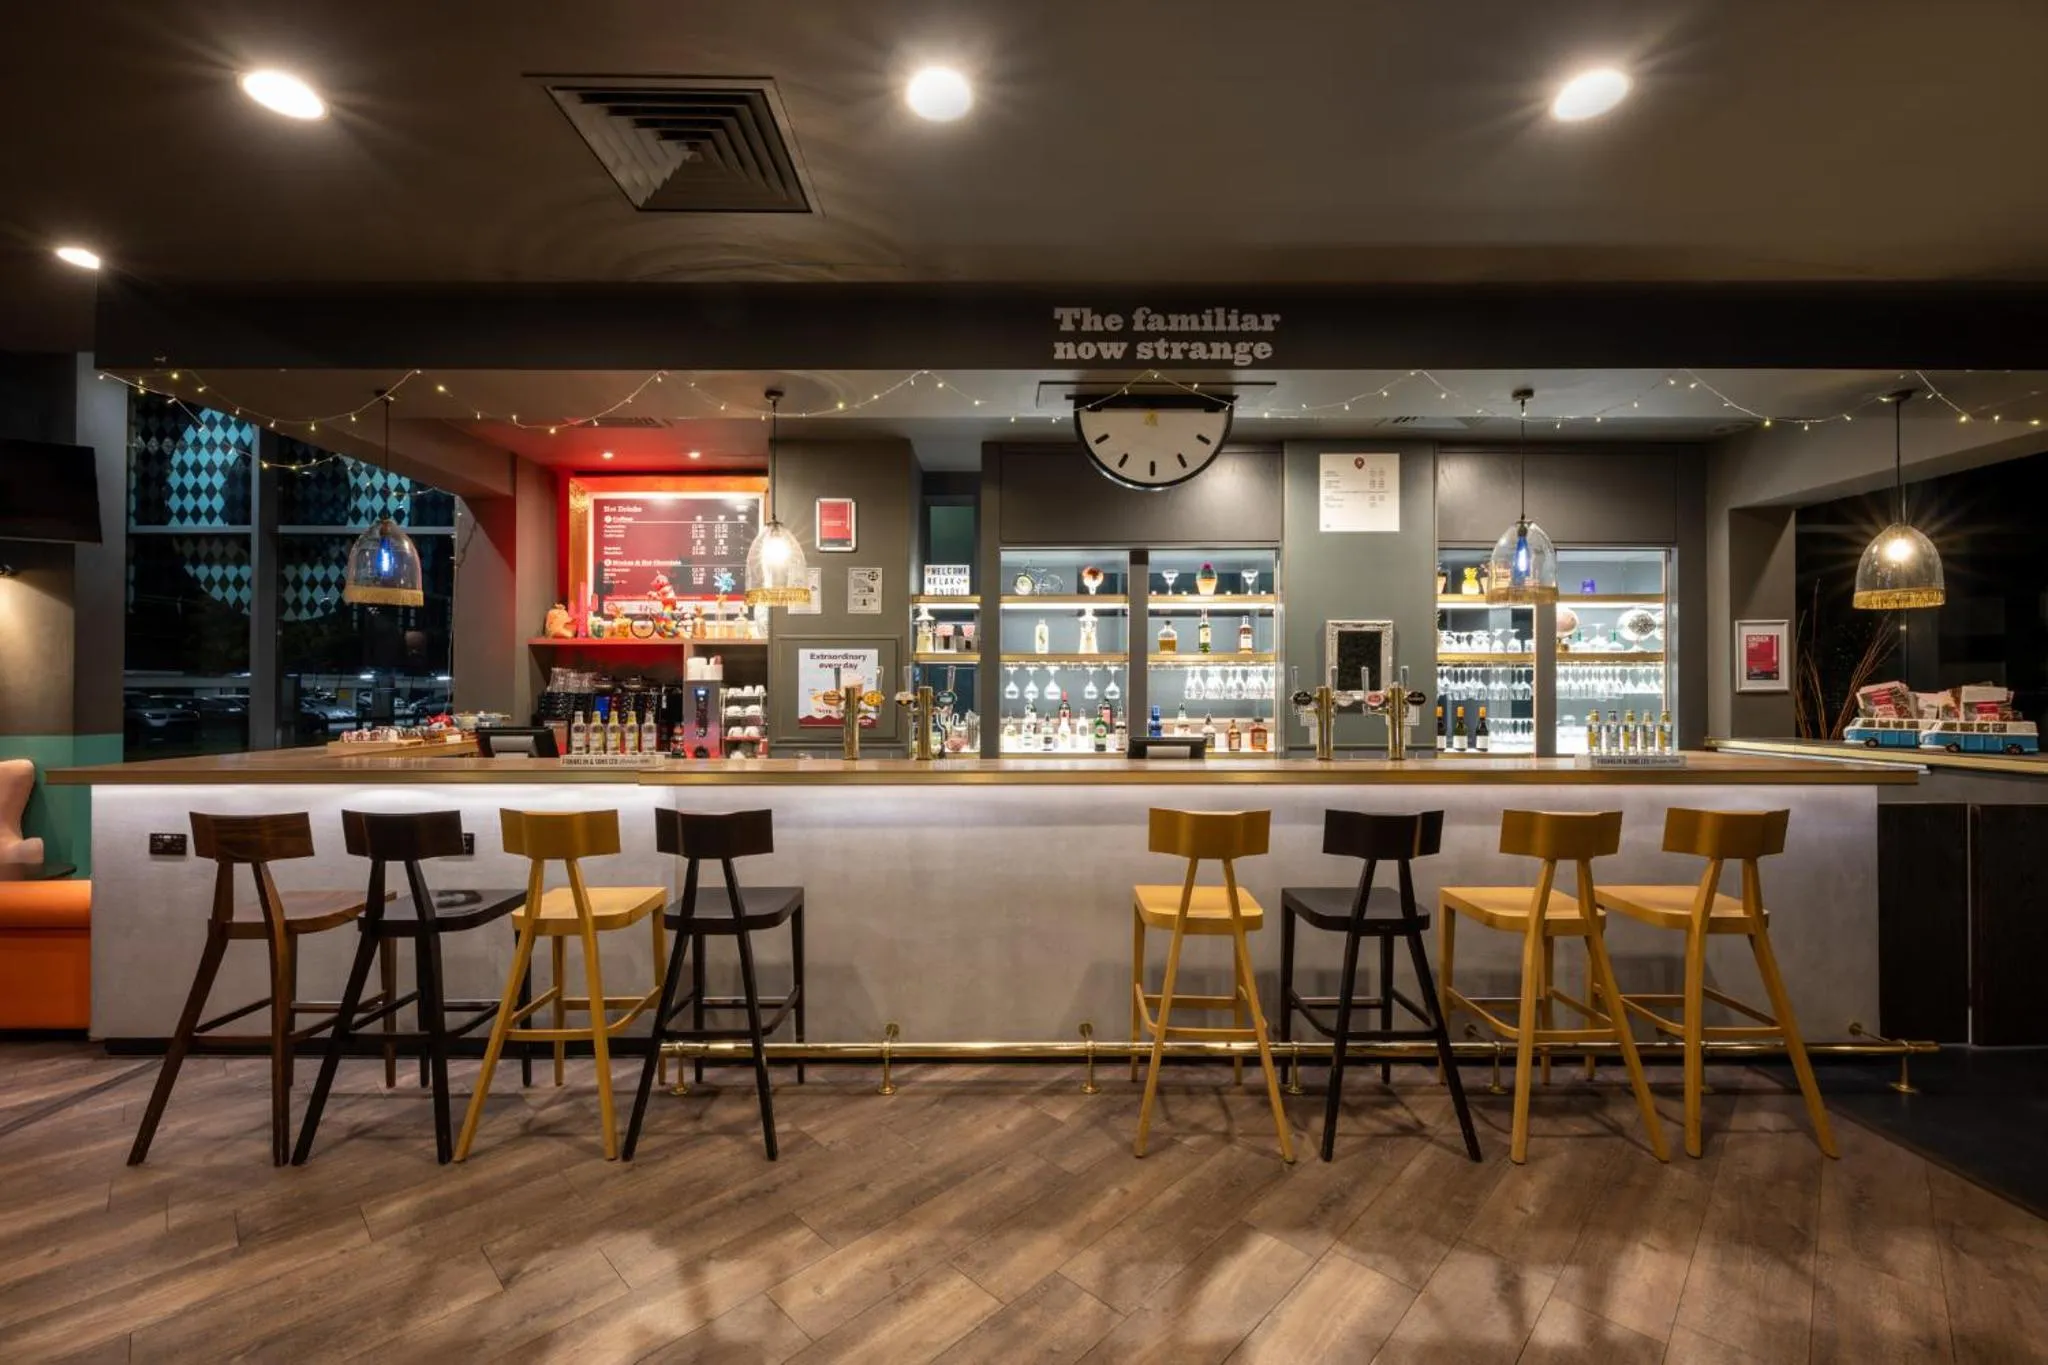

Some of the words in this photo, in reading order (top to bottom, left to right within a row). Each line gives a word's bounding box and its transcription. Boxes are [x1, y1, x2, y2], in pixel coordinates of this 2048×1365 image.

[1054, 307, 1124, 332] The
[1132, 307, 1281, 332] familiar
[1053, 342, 1129, 360] now
[1136, 338, 1274, 366] strange
[931, 567, 969, 576] WELCOME
[809, 652, 868, 662] Extraordinary
[843, 661, 858, 670] day
